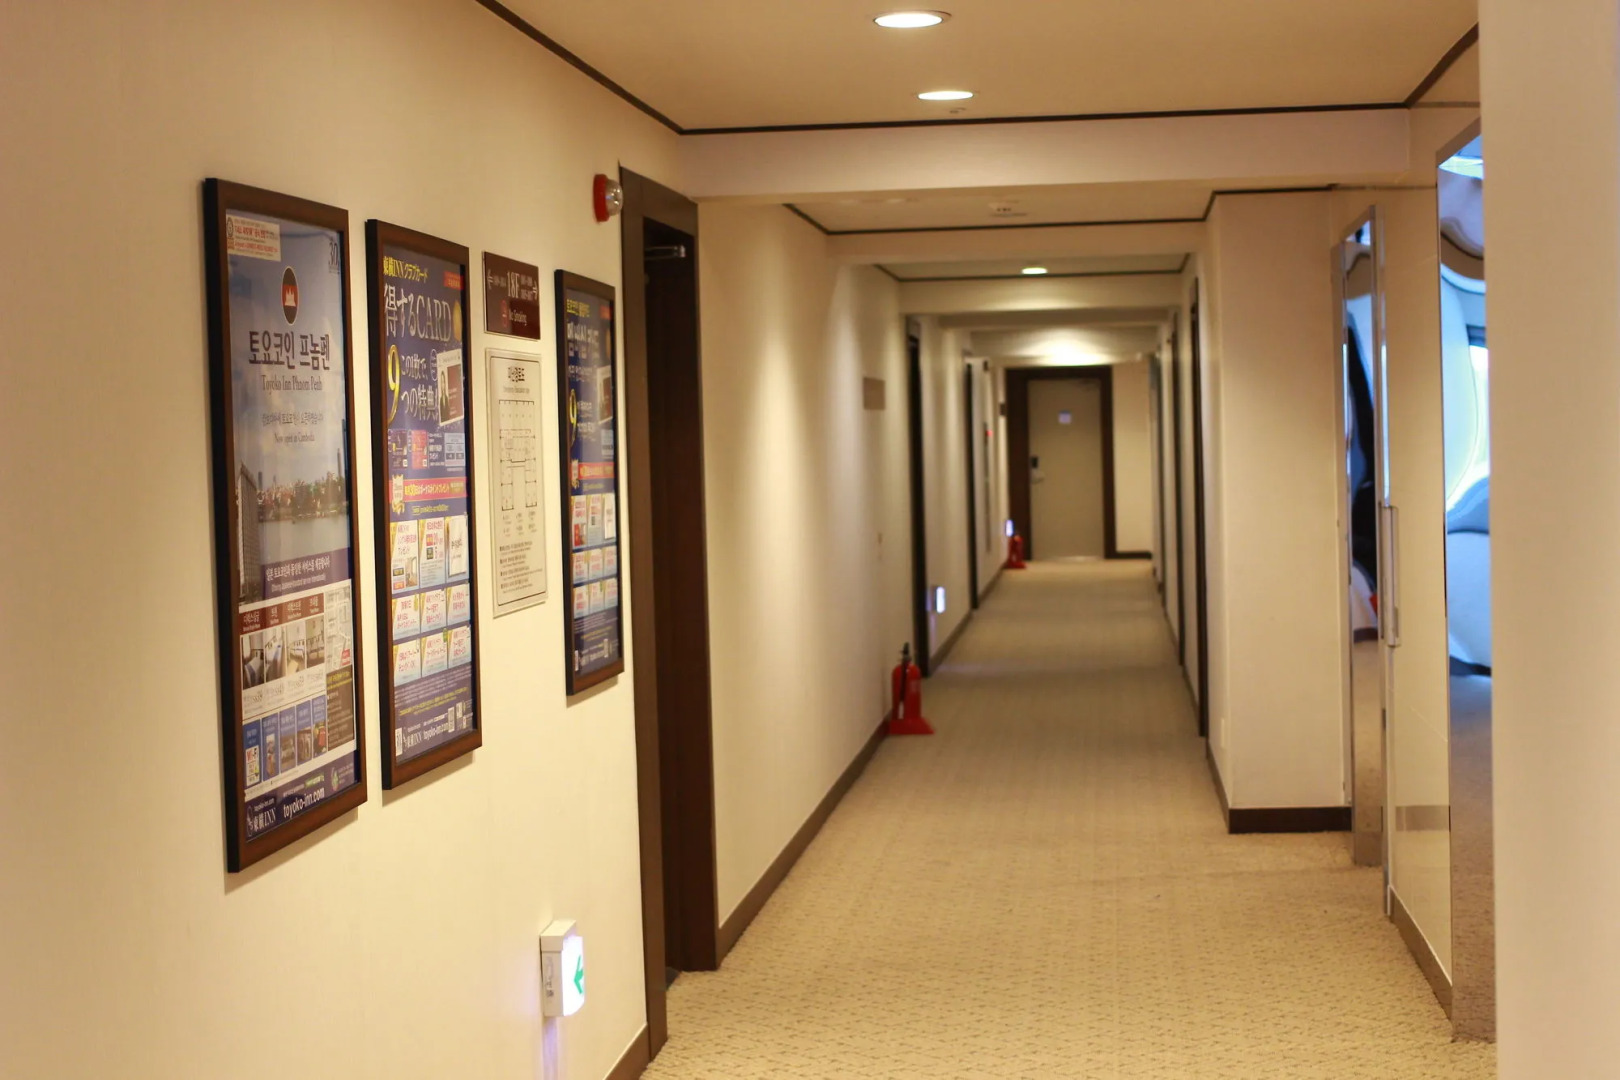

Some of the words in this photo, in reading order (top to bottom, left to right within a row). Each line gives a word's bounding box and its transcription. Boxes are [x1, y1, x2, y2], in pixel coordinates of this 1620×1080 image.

[507, 271, 520, 298] 18F
[384, 282, 452, 341] 得するCARD
[249, 330, 295, 369] 토요코인
[299, 334, 330, 370] 프놈펜
[261, 374, 282, 395] Toyoko
[282, 375, 291, 390] Inn
[292, 375, 310, 391] Phnom
[310, 376, 322, 391] Penh
[388, 344, 400, 425] 9
[283, 787, 325, 820] toyoko-inn.com
